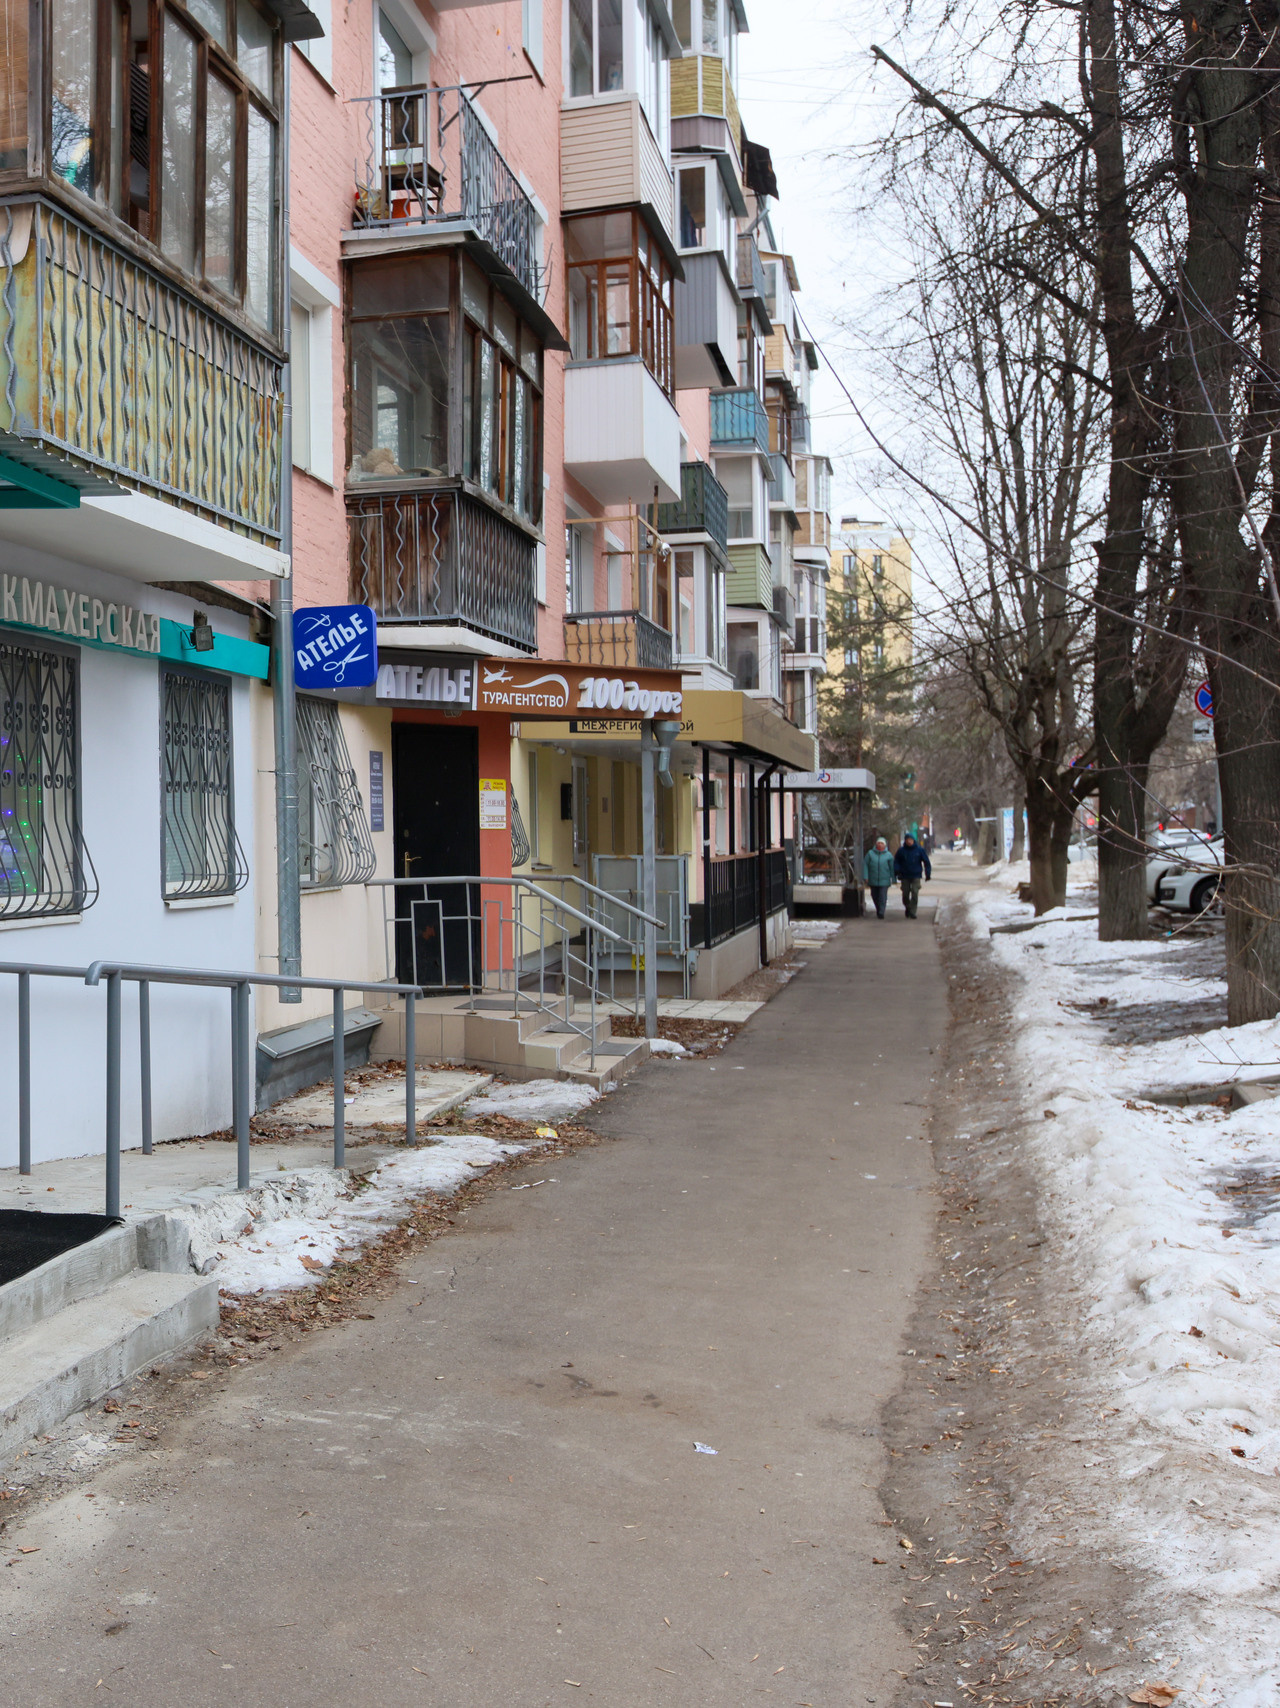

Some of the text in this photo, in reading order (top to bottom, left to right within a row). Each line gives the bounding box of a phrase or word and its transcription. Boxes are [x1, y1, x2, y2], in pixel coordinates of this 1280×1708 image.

[297, 612, 369, 671] АТЕЛЬЕ
[376, 664, 471, 703] АТЕЛЬЕ
[482, 691, 564, 708] ТУРАГЕНТСТВО
